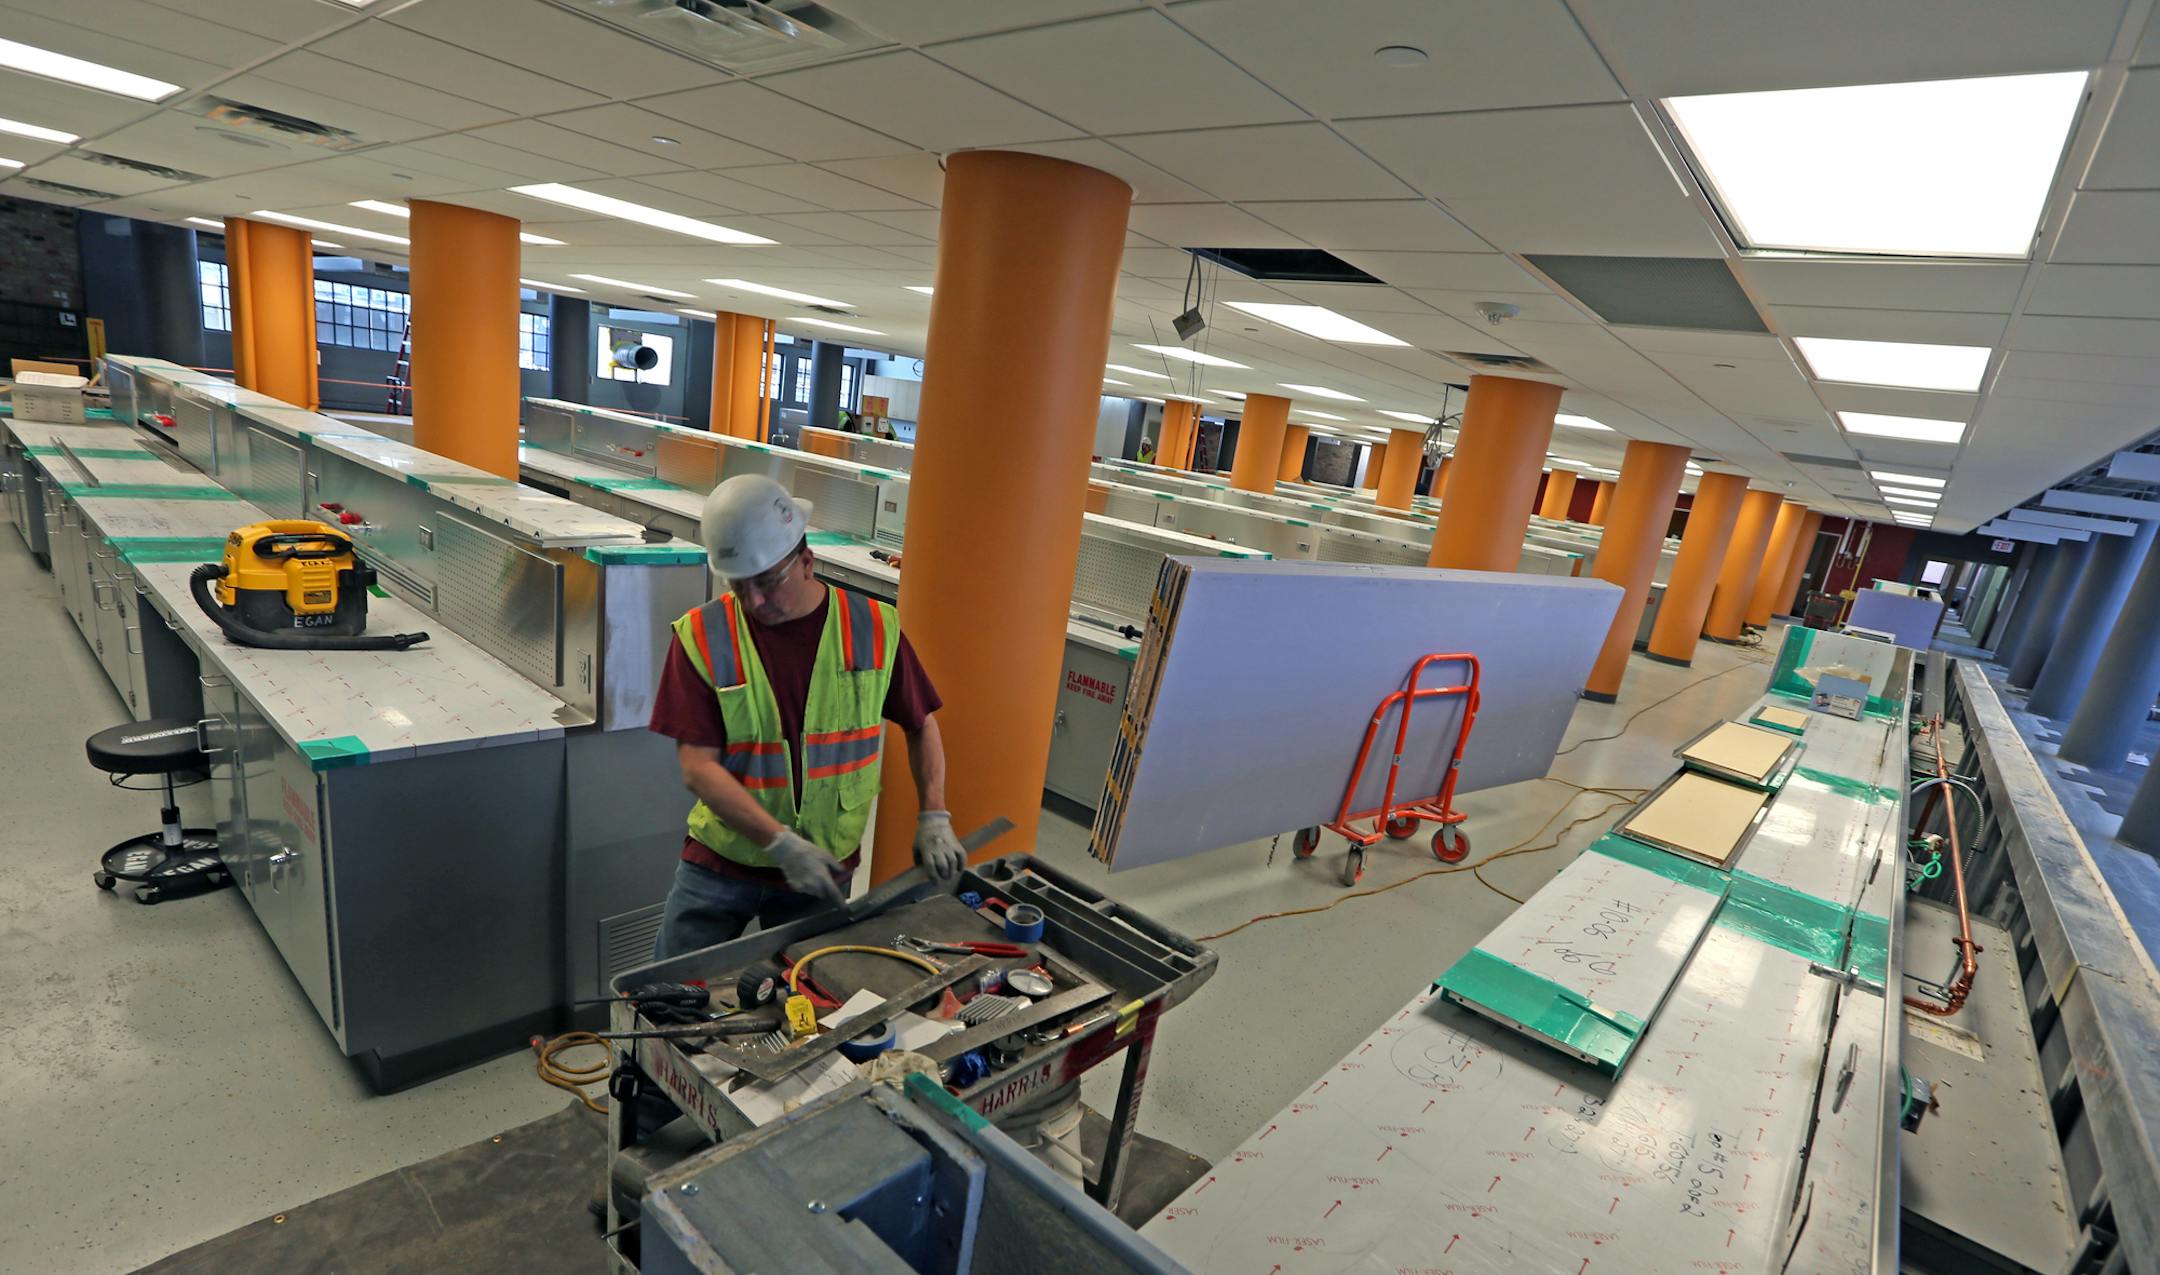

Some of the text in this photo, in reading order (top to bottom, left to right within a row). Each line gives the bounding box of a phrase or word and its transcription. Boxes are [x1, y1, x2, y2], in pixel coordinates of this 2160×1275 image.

[294, 615, 333, 628] EGAN
[1065, 682, 1081, 693] KEEP
[1082, 687, 1096, 699] FIRE
[1067, 670, 1116, 697] FLAMMABLE
[657, 1057, 718, 1127] HARRIS
[981, 1063, 1052, 1116] HARRIS
